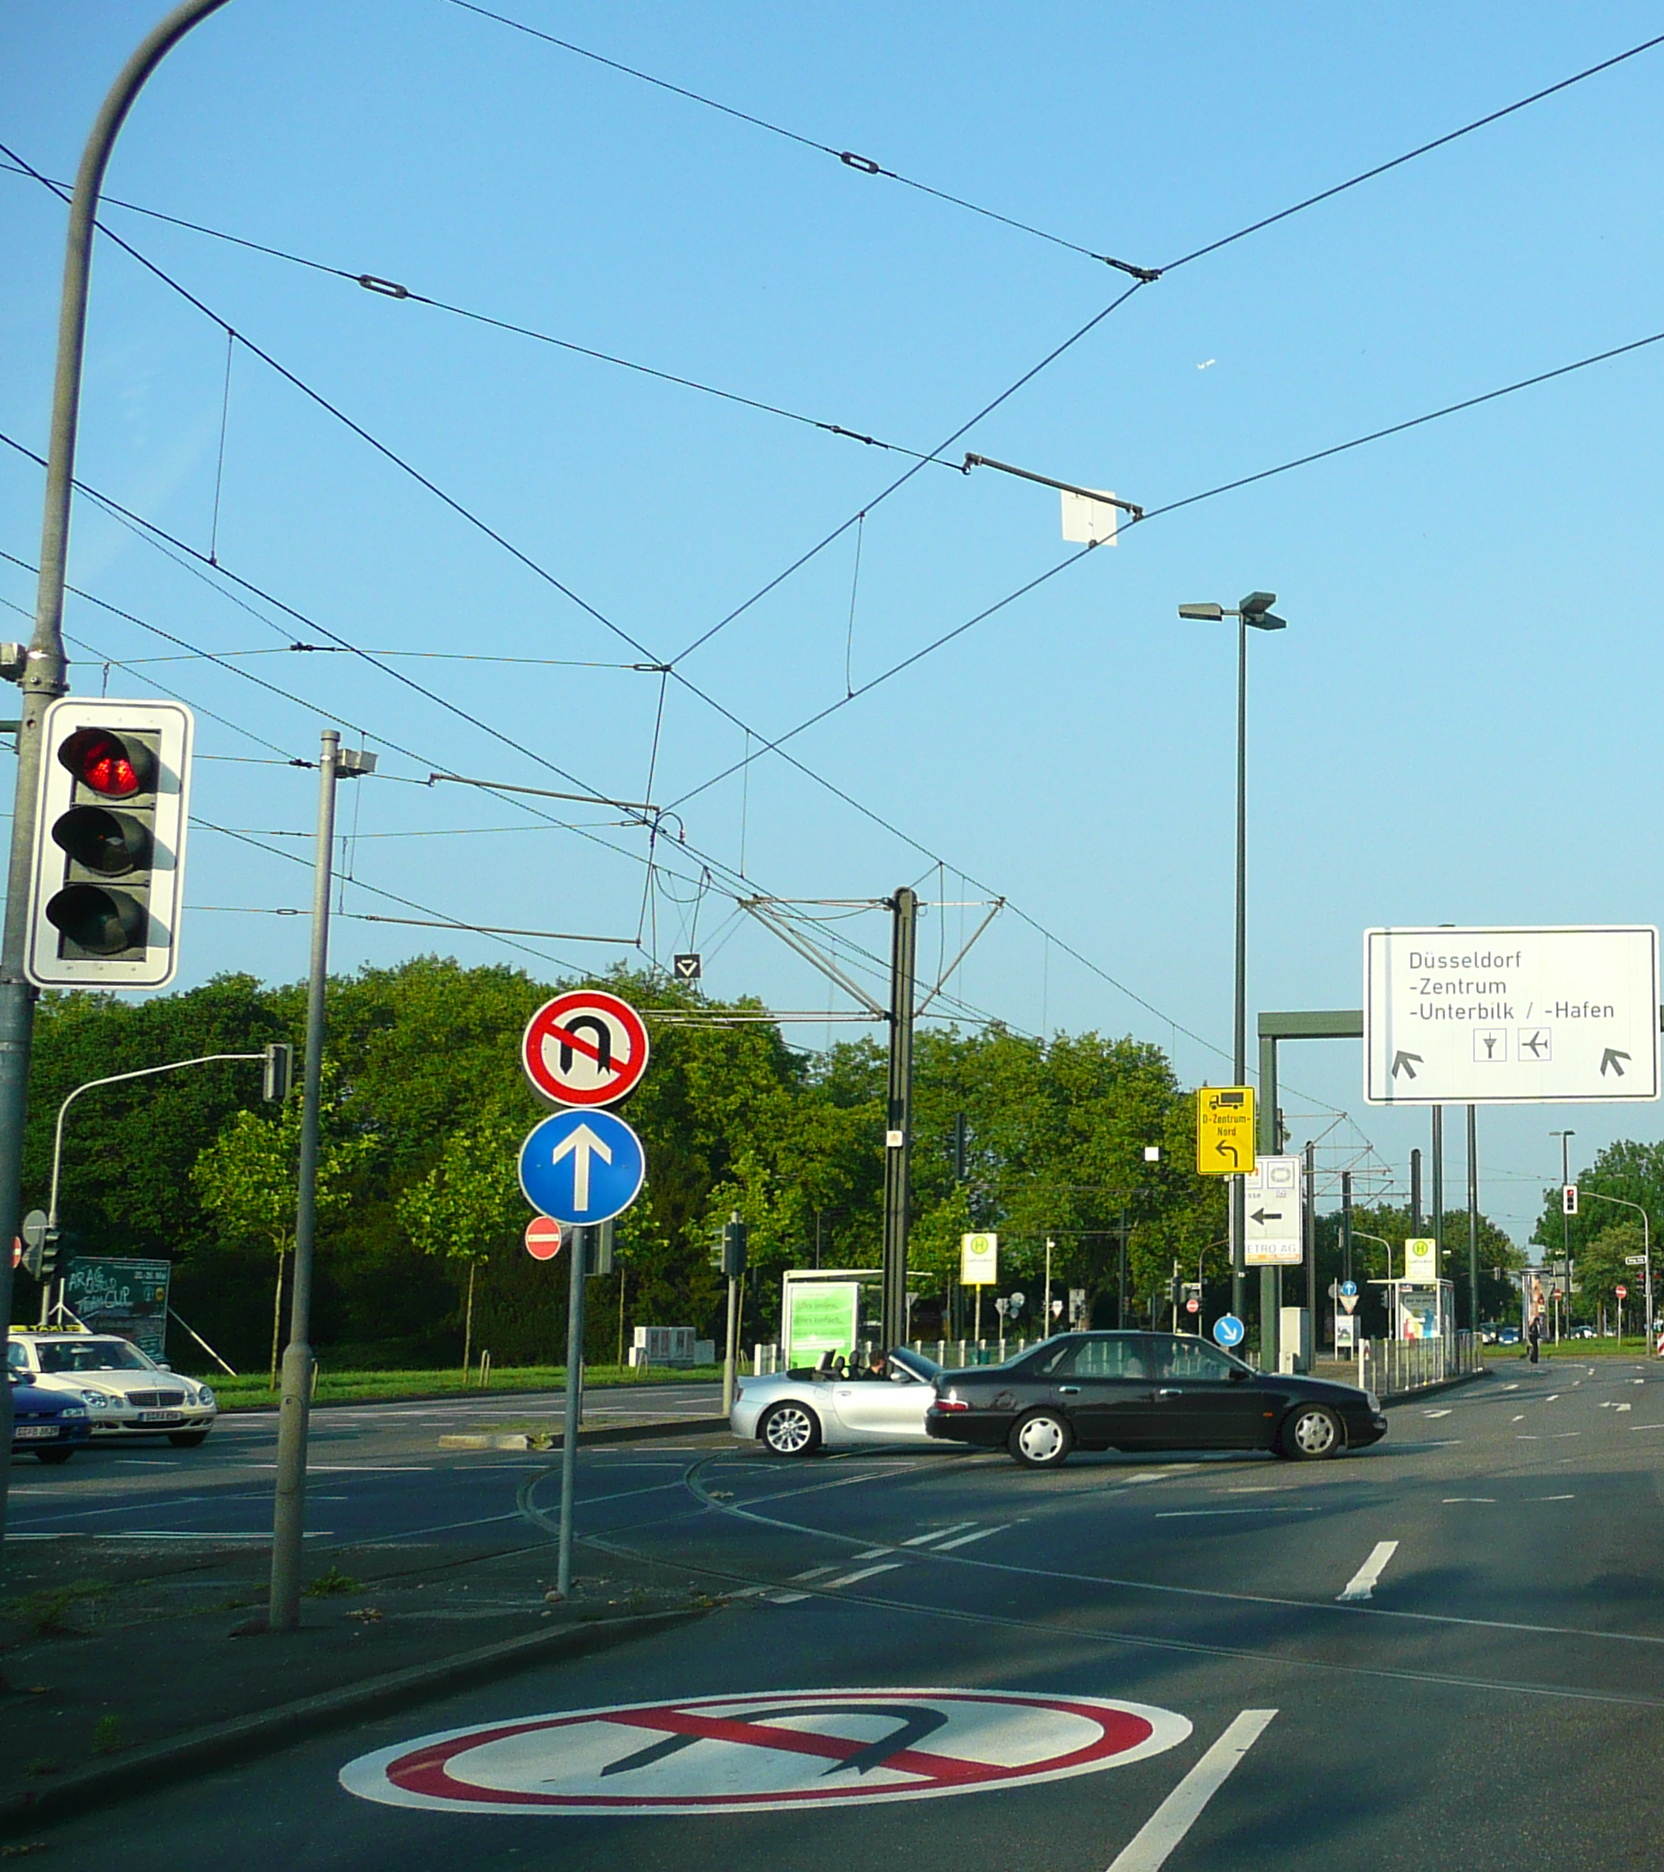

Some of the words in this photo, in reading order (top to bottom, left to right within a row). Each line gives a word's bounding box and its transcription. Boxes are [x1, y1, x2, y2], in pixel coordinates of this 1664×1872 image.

[1409, 951, 1522, 969] Düsseldorf
[1409, 978, 1507, 995] -Zentrum
[1409, 1002, 1515, 1020] -Unterbilk
[1544, 1001, 1615, 1018] -Hafen
[1217, 1126, 1237, 1136] Nord
[1247, 1244, 1276, 1253] ETRO
[1280, 1243, 1297, 1253] AG
[68, 1266, 104, 1291] ARAG
[105, 1286, 130, 1308] CUP
